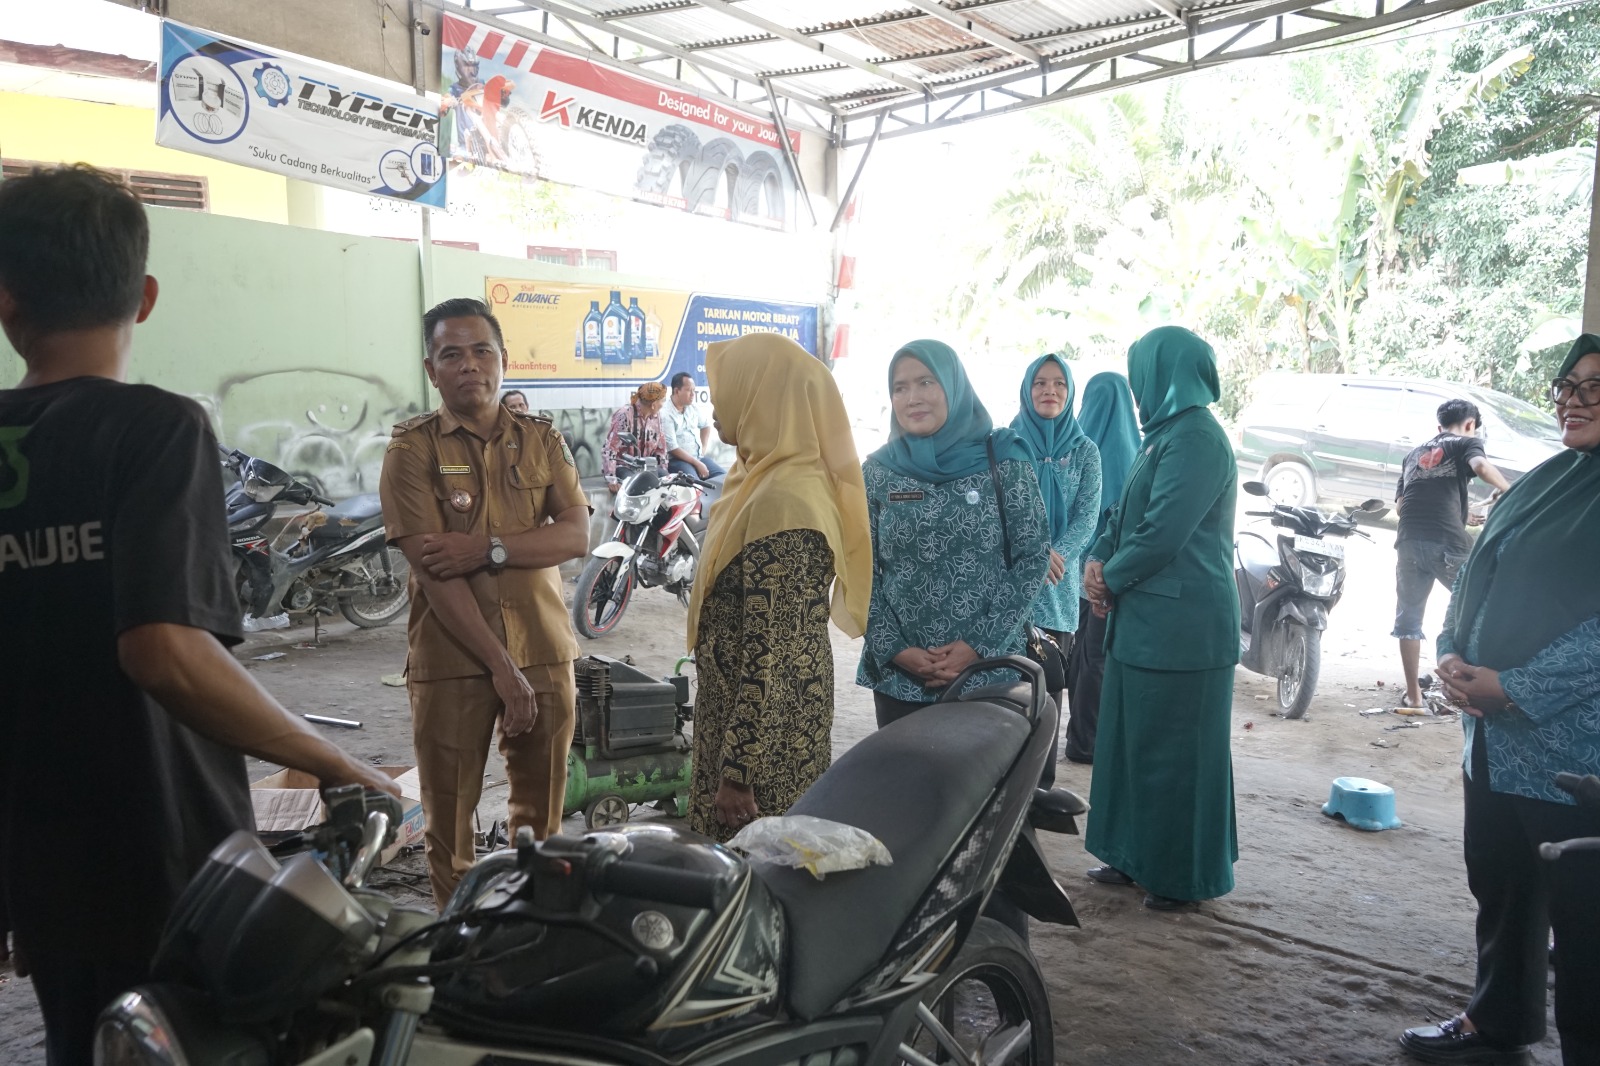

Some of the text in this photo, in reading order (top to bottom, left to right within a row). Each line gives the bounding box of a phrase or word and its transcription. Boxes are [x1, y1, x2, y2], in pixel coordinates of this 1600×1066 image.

[297, 98, 436, 143] TECHNOLOGY PERFORMANCE
[658, 91, 711, 121] Designed
[713, 107, 729, 126] for
[731, 118, 755, 134] your
[576, 106, 647, 143] KENDA
[280, 153, 318, 174] Cadang
[512, 292, 561, 305] ADVANCE
[703, 307, 800, 325] TARIKAN MOTOR BERAT?
[697, 322, 740, 337] DIBAWA
[236, 535, 261, 543] HONDA
